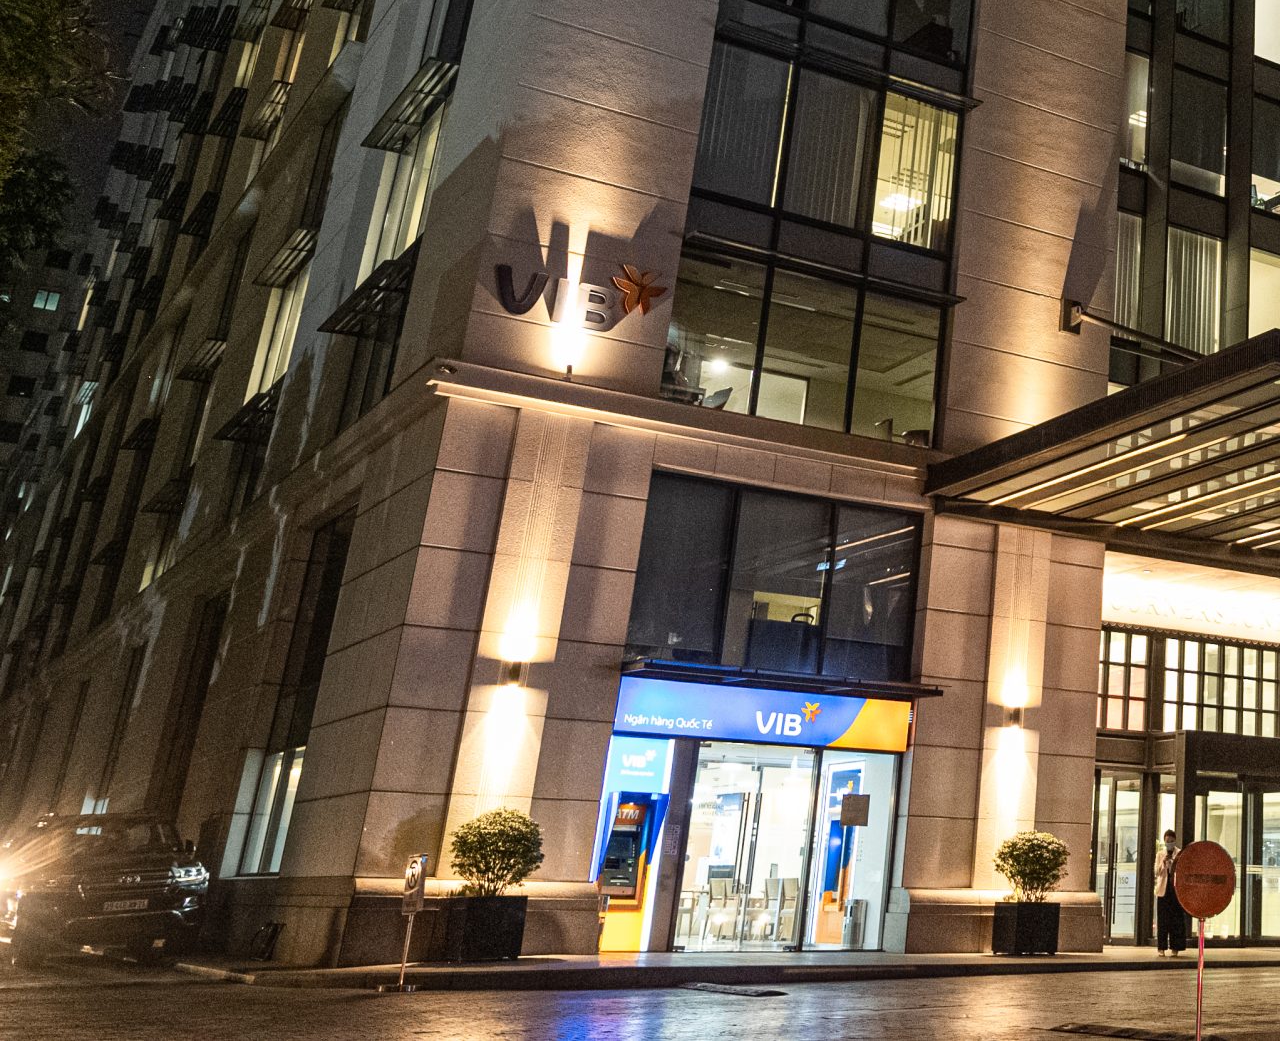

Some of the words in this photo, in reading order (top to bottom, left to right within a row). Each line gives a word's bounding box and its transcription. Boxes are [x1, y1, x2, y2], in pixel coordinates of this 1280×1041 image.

[496, 264, 617, 333] VIB
[624, 713, 649, 725] Ngân
[650, 715, 673, 727] hàng
[755, 710, 803, 737] VIB
